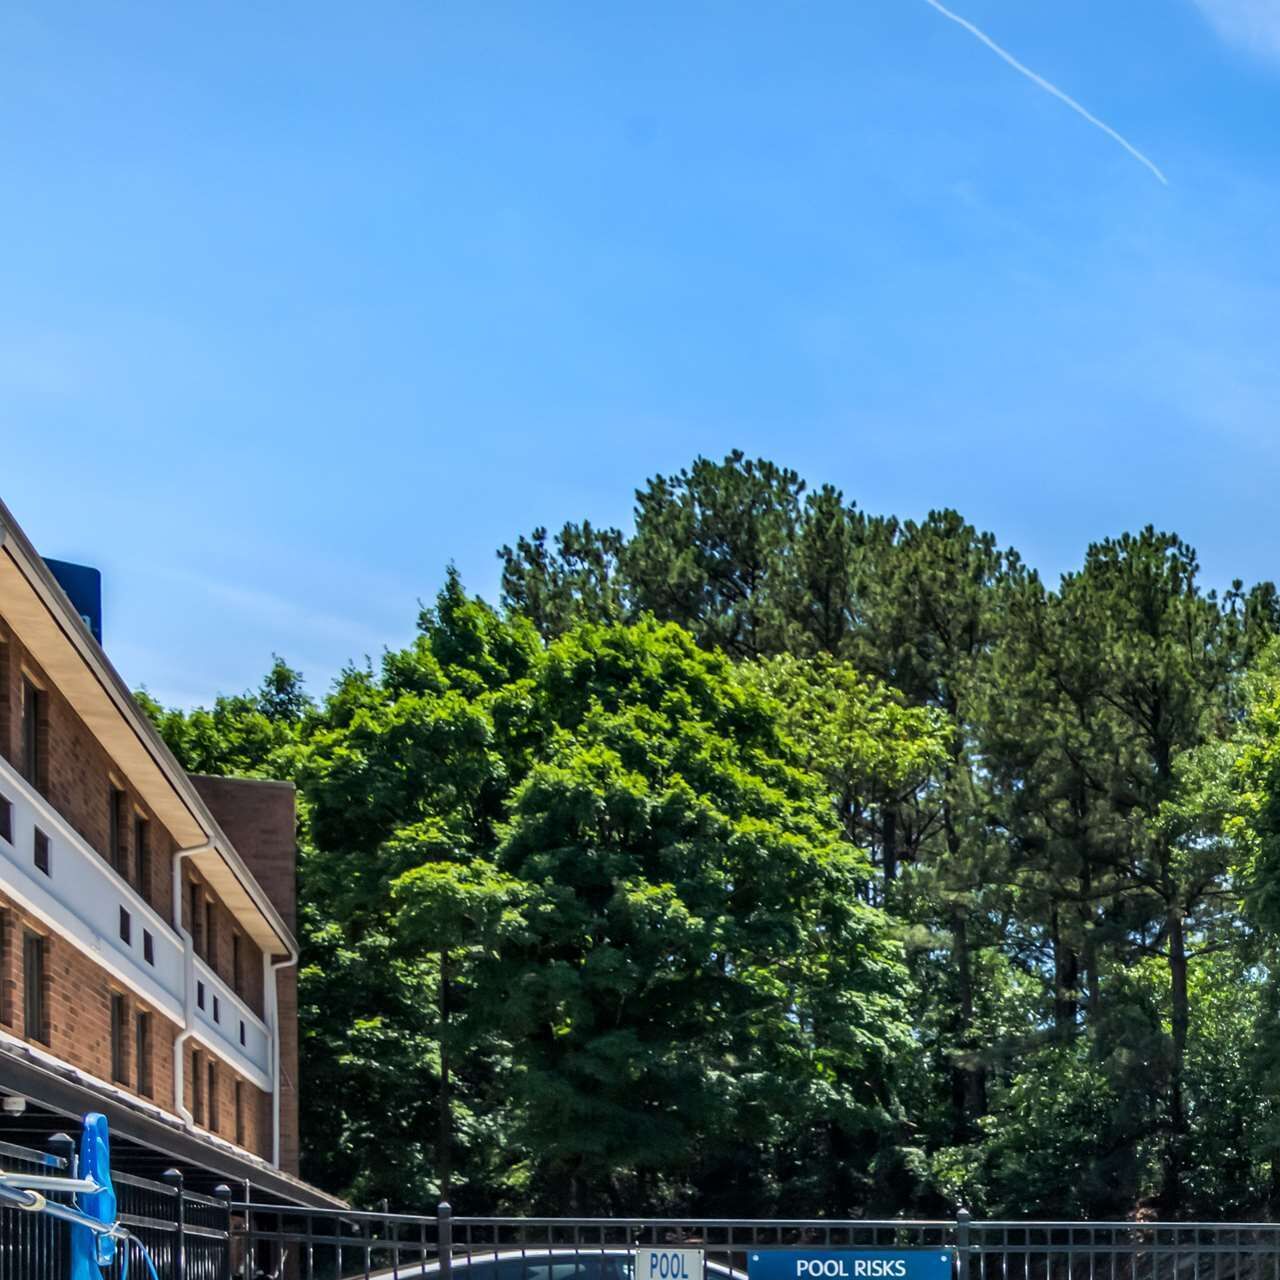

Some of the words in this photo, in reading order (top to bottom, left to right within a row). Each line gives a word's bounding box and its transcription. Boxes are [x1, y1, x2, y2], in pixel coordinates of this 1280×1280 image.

[650, 1252, 689, 1279] POOL
[797, 1260, 848, 1276] POOL
[854, 1260, 906, 1276] RISKS
